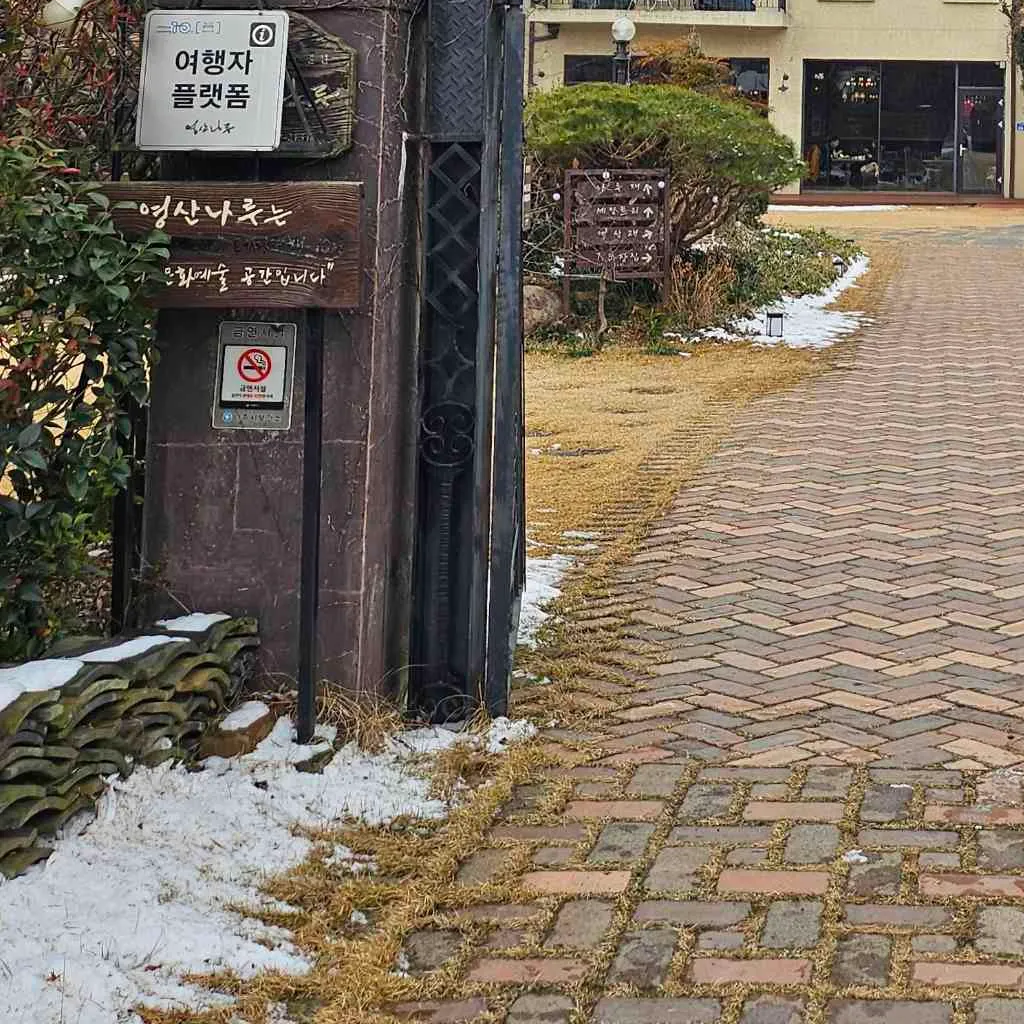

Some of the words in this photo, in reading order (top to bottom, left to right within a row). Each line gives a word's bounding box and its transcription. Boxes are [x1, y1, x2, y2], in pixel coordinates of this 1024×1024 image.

[175, 49, 253, 76] 여행자
[171, 83, 250, 109] 플랫폼
[139, 195, 293, 228] 영산나루는
